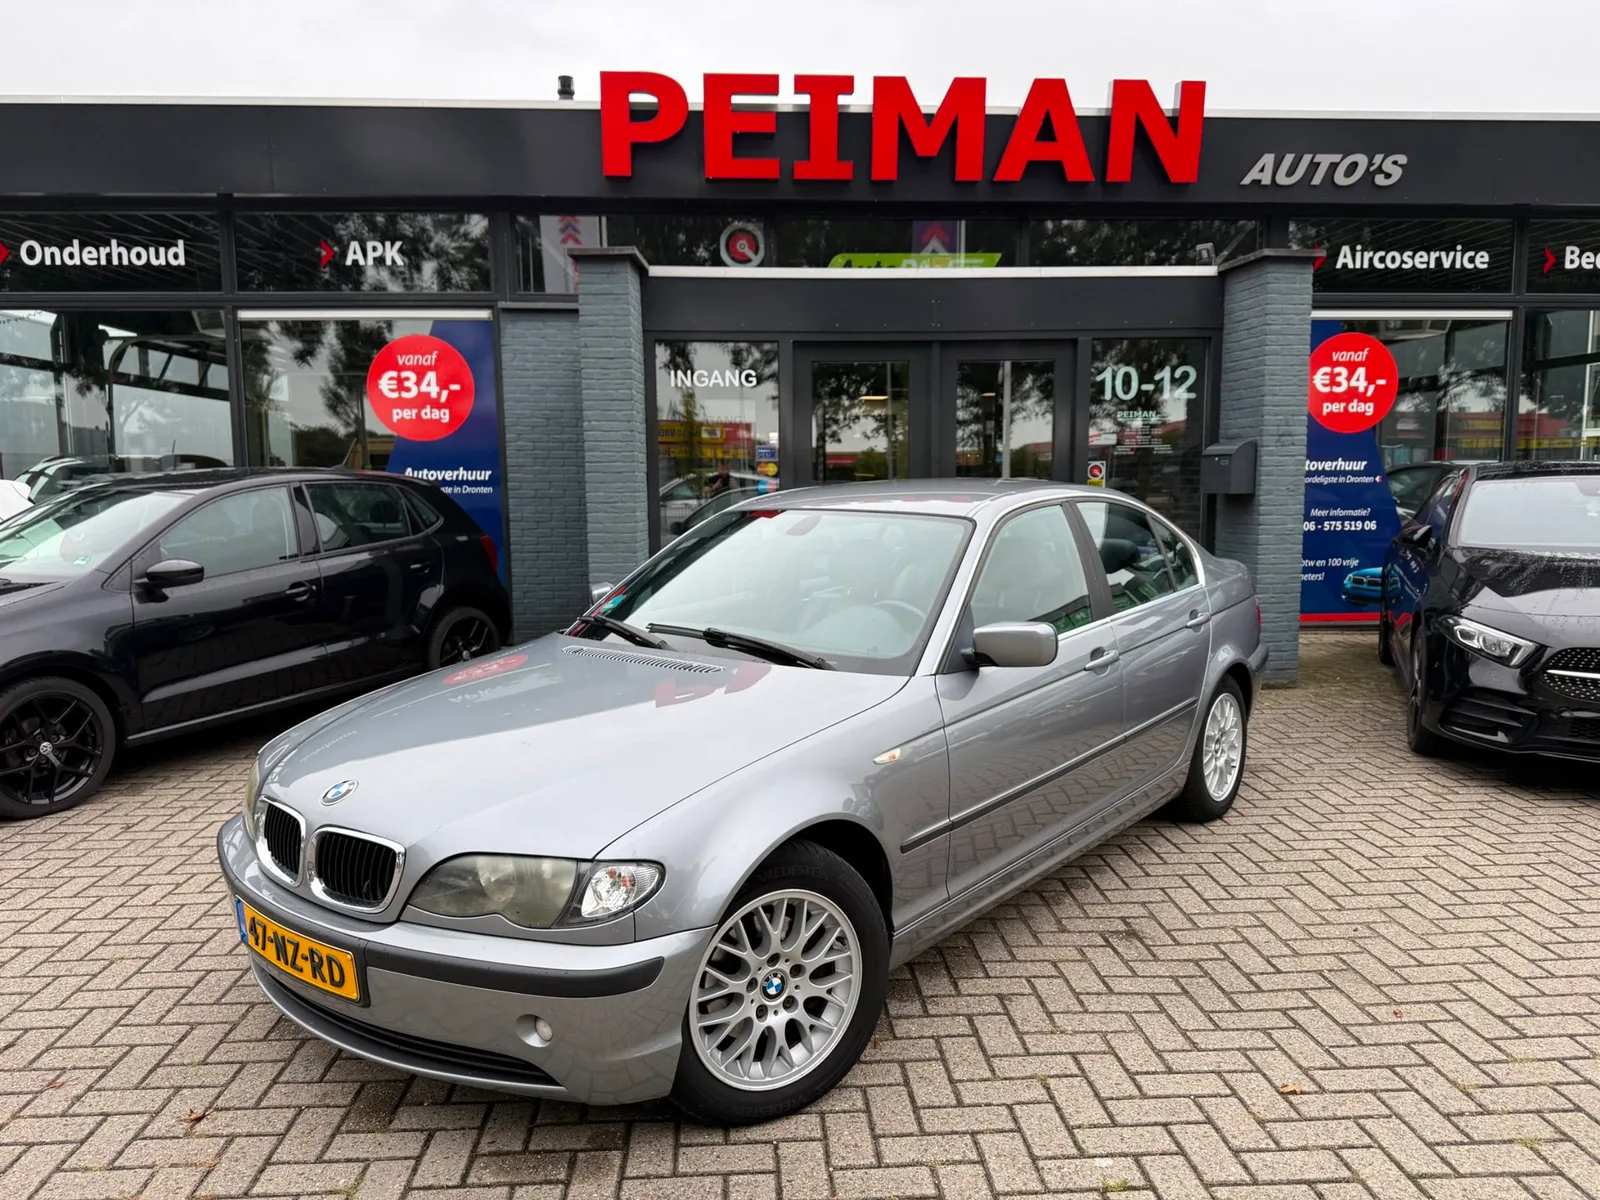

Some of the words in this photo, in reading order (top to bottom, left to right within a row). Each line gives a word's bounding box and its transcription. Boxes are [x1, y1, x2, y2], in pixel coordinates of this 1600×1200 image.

[600, 71, 1206, 183] PEIMAN
[1239, 153, 1408, 187] AUTO'S
[20, 239, 186, 266] Onderhoud
[345, 240, 404, 266] APK
[1335, 244, 1489, 269] Aircoservice
[397, 351, 438, 366] vanaf
[1332, 347, 1369, 362] vanaf
[378, 371, 461, 403] €34,-
[670, 369, 758, 388] INGANG
[1095, 365, 1197, 400] 10-12
[1313, 366, 1387, 397] €34,-
[392, 408, 418, 423] per
[421, 405, 450, 423] dag
[1117, 411, 1157, 419] PEIMAN
[1322, 402, 1346, 416] per
[1348, 399, 1374, 416] dag
[405, 467, 492, 481] Autoverhuur
[1339, 475, 1346, 483] in
[1346, 475, 1374, 483] Dronten
[454, 485, 461, 494] in
[462, 485, 493, 494] Dronten
[1310, 508, 1329, 517] Meer
[1329, 508, 1371, 517] informatie?
[1303, 521, 1316, 531] 06
[1323, 521, 1342, 531] 575
[1344, 521, 1363, 531] 519
[1364, 521, 1377, 531] 06
[1316, 559, 1326, 567] en
[1328, 557, 1342, 567] 100
[1342, 557, 1359, 568] vrije
[249, 917, 345, 988] 47-NZ-RD
